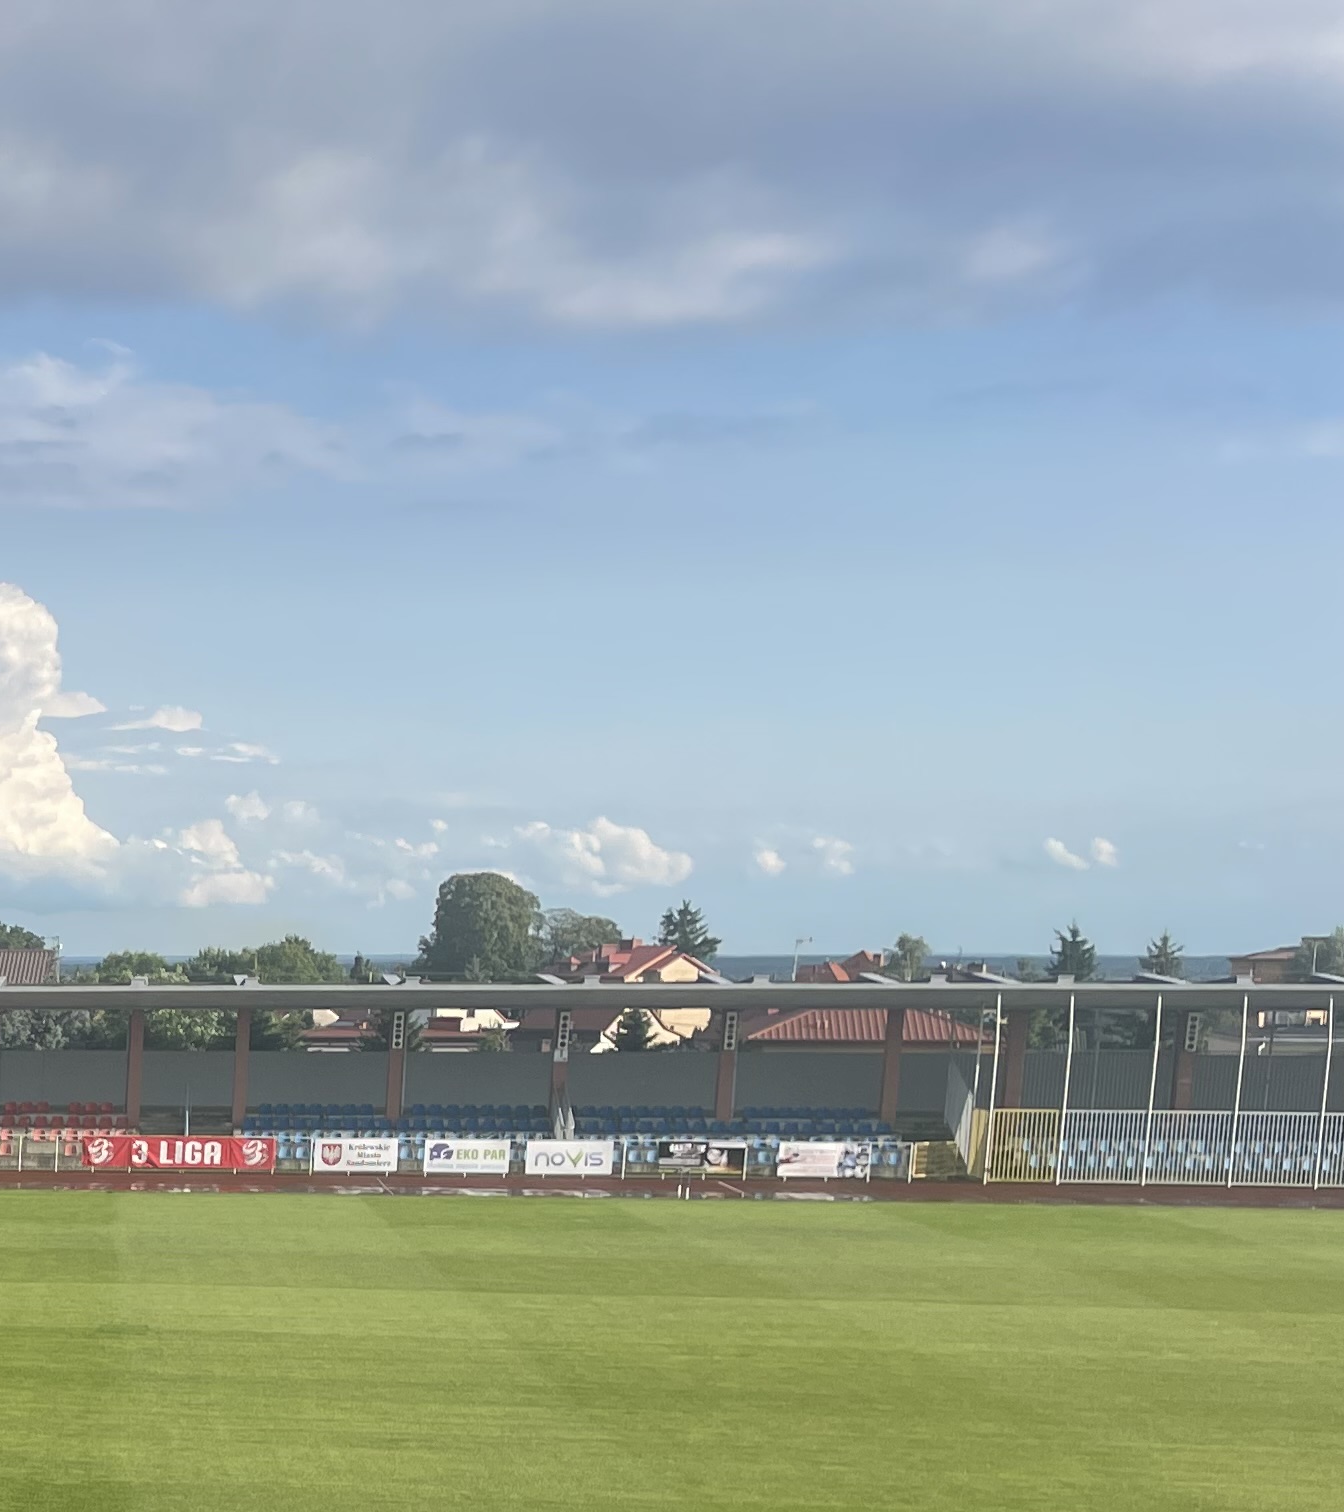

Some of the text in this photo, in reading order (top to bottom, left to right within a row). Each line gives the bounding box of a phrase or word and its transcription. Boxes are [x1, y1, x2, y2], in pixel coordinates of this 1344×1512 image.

[132, 1140, 222, 1165] 3 LIGA
[456, 1149, 506, 1161] EKO PAR
